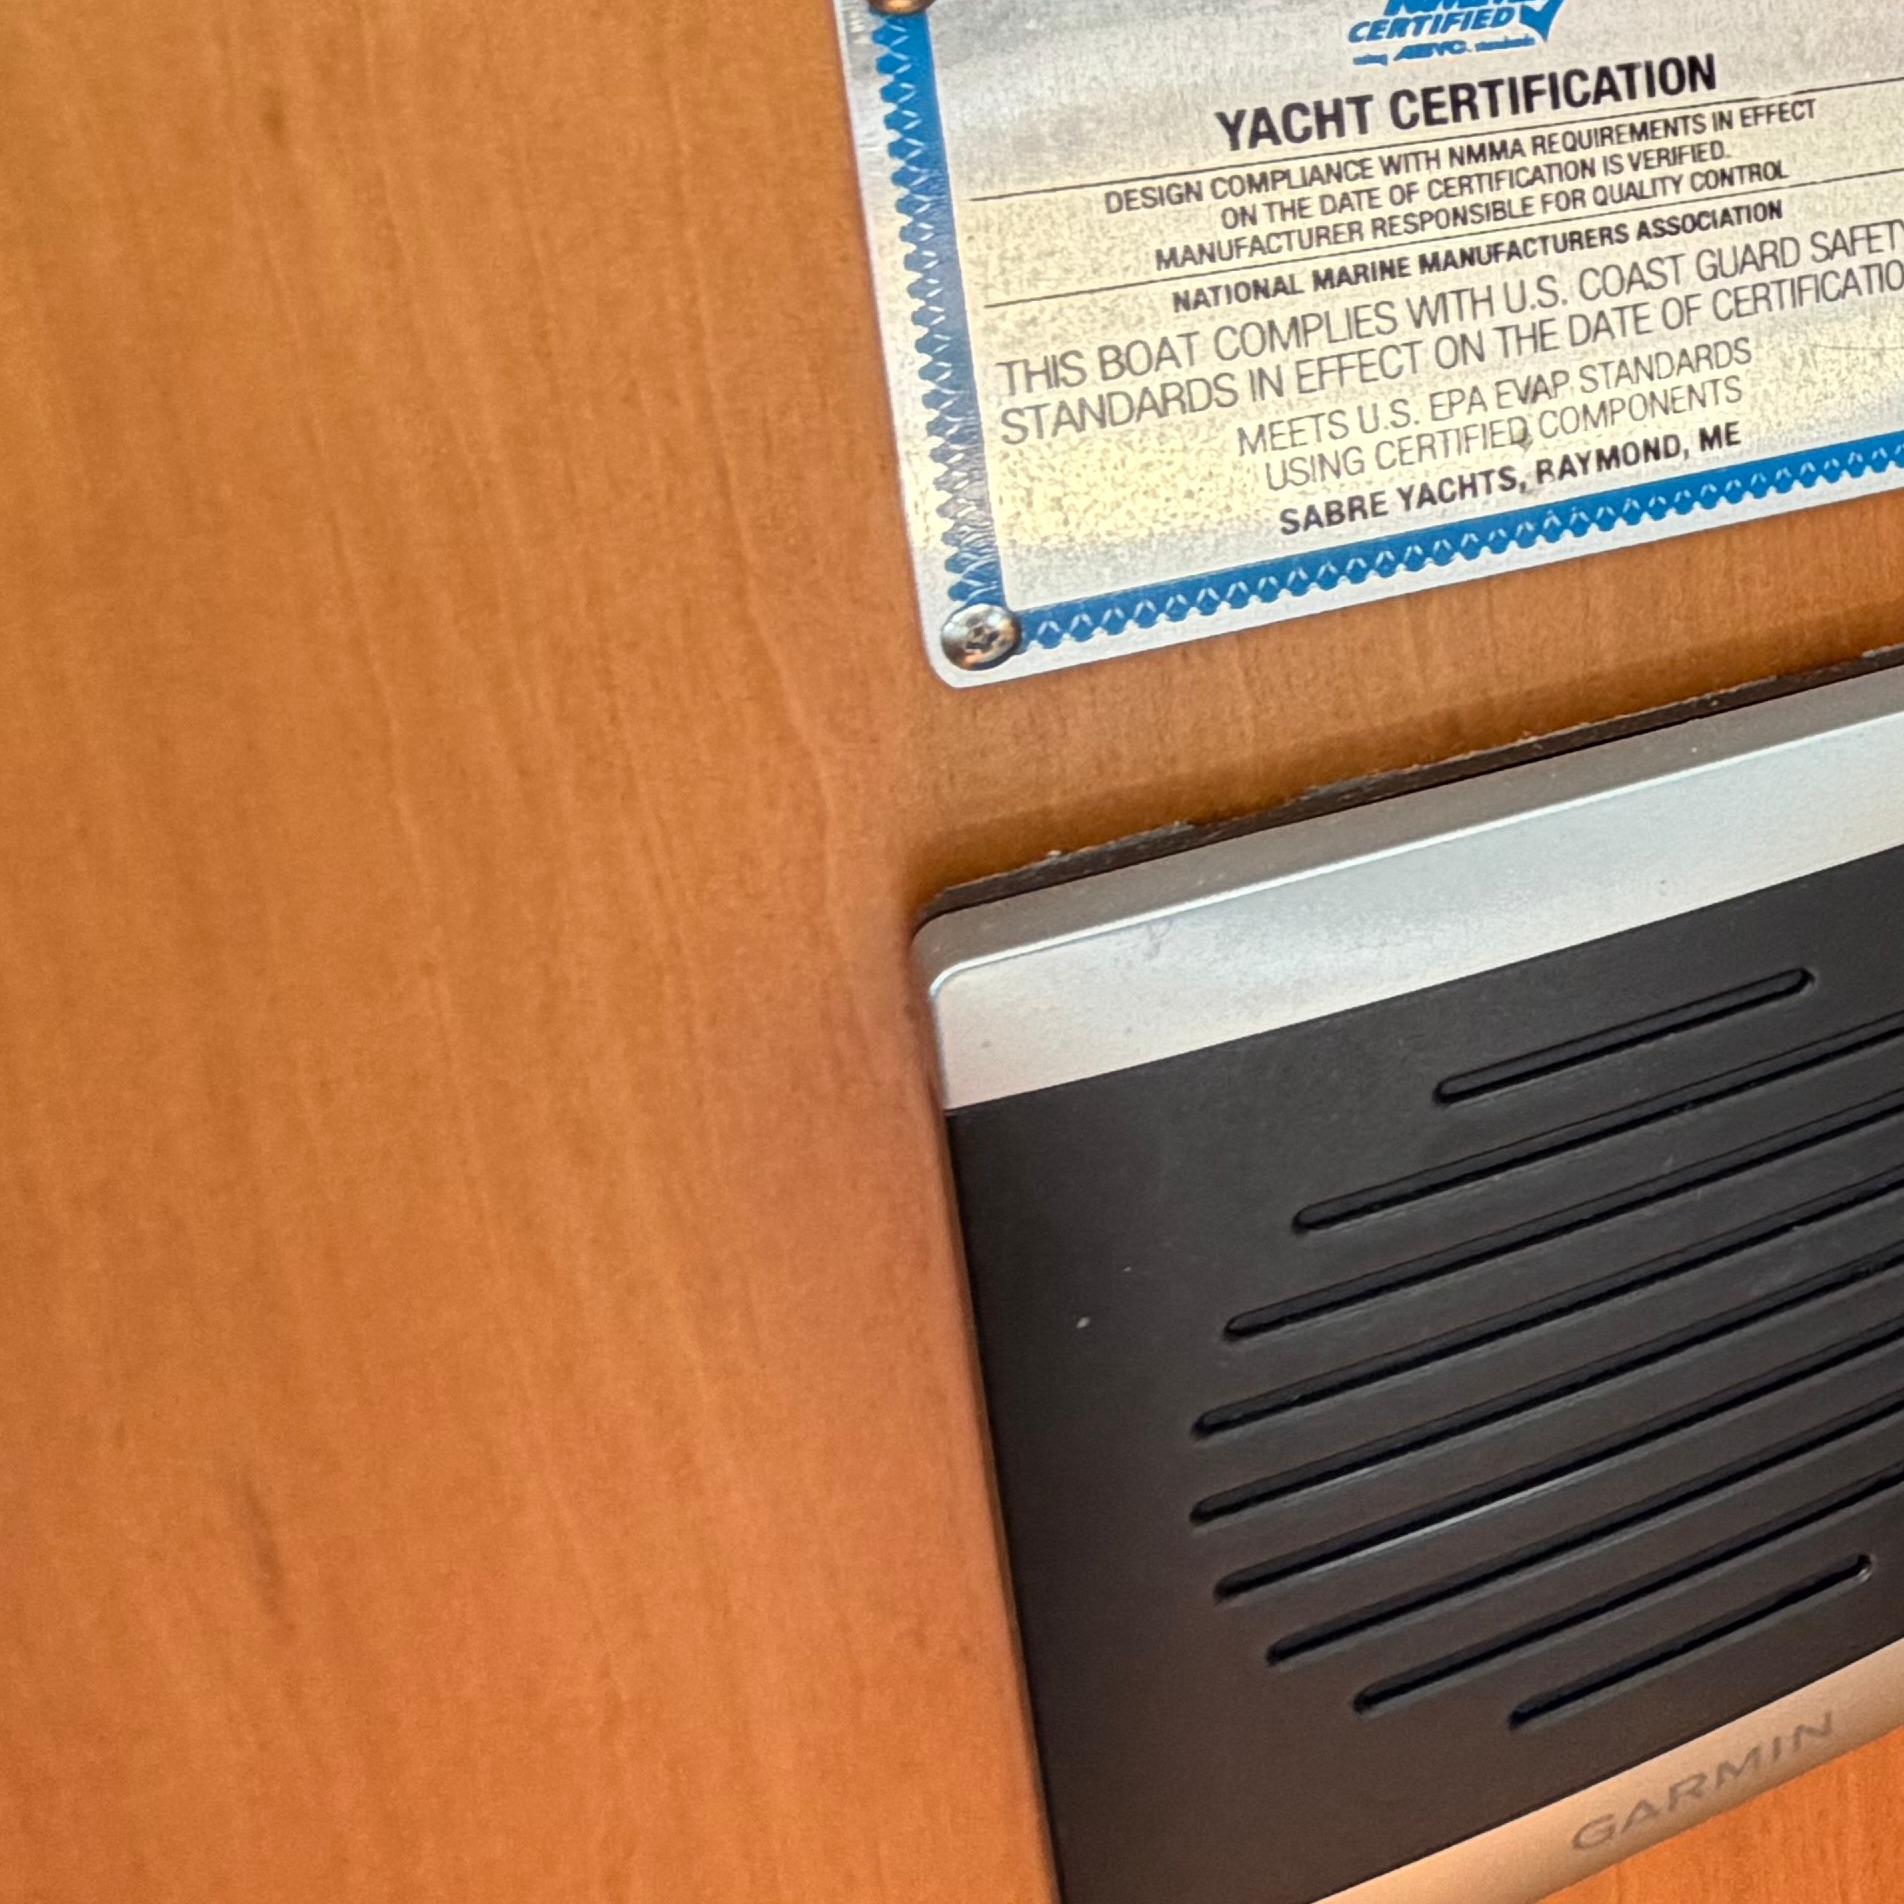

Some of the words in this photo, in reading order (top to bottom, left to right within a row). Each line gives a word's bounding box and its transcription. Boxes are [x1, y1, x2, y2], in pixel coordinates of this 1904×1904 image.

[1348, 6, 1516, 43] CERTIFIED
[1104, 180, 1204, 214] DESIGN
[1210, 157, 1373, 199] COMPLIANCE
[1379, 148, 1441, 176] WITH
[1448, 137, 1527, 168] NMMA
[1531, 113, 1707, 157] REQUIREMENTS
[1712, 109, 1734, 133] IN
[1740, 98, 1817, 129] EFFECT
[1214, 94, 1374, 152] YACHT
[1389, 53, 1717, 130] CERTIFICATION
[1155, 220, 1365, 271] MANUFACTURER
[1371, 195, 1534, 239] RESPONSIBLE
[1542, 187, 1587, 214] FOR
[1592, 174, 1684, 207] QUALITY
[1690, 160, 1790, 193] CONTROL
[1221, 204, 1258, 229] ON
[1262, 197, 1314, 224] THE
[1318, 186, 1383, 216] DATE
[1388, 182, 1420, 207] OF
[1427, 157, 1596, 202] CERTIFICATION
[1602, 152, 1624, 176] IS
[1627, 139, 1731, 173] VERIFIED.
[1172, 273, 1305, 313] NATIONAL
[1311, 257, 1411, 292] MARINE
[1418, 220, 1629, 276] MANUFACTURERS
[1636, 199, 1784, 241] ASSOCIATION
[995, 349, 1088, 396] THIS
[1099, 331, 1200, 382] BOAT
[1213, 299, 1399, 362] COMPLIES
[1405, 284, 1494, 330] WITH
[1503, 274, 1569, 314] U.S.
[1578, 253, 1685, 300] COAST
[1695, 235, 1801, 282] GUARD
[1000, 372, 1238, 445] STANDARDS
[1248, 364, 1284, 402] IN
[1297, 340, 1424, 393] EFFECT
[1434, 335, 1484, 370] ON
[1497, 318, 1560, 359] THE
[1568, 302, 1653, 348] DATE
[1661, 293, 1702, 331] OF
[1237, 409, 1349, 457] MEETS
[1357, 398, 1420, 434] U.S.
[1430, 386, 1488, 422] EPA
[1579, 336, 1752, 395] STANDARDS
[1265, 446, 1366, 492] USING
[1375, 415, 1528, 467] CERTIFIED
[1538, 375, 1743, 438] COMPONENTS
[1279, 491, 1389, 536] SABRE
[1397, 464, 1526, 513] YACHTS,
[1536, 432, 1690, 486] RAYMOND,
[1699, 421, 1742, 451] ME
[1571, 1710, 1836, 1853] GARMIN
